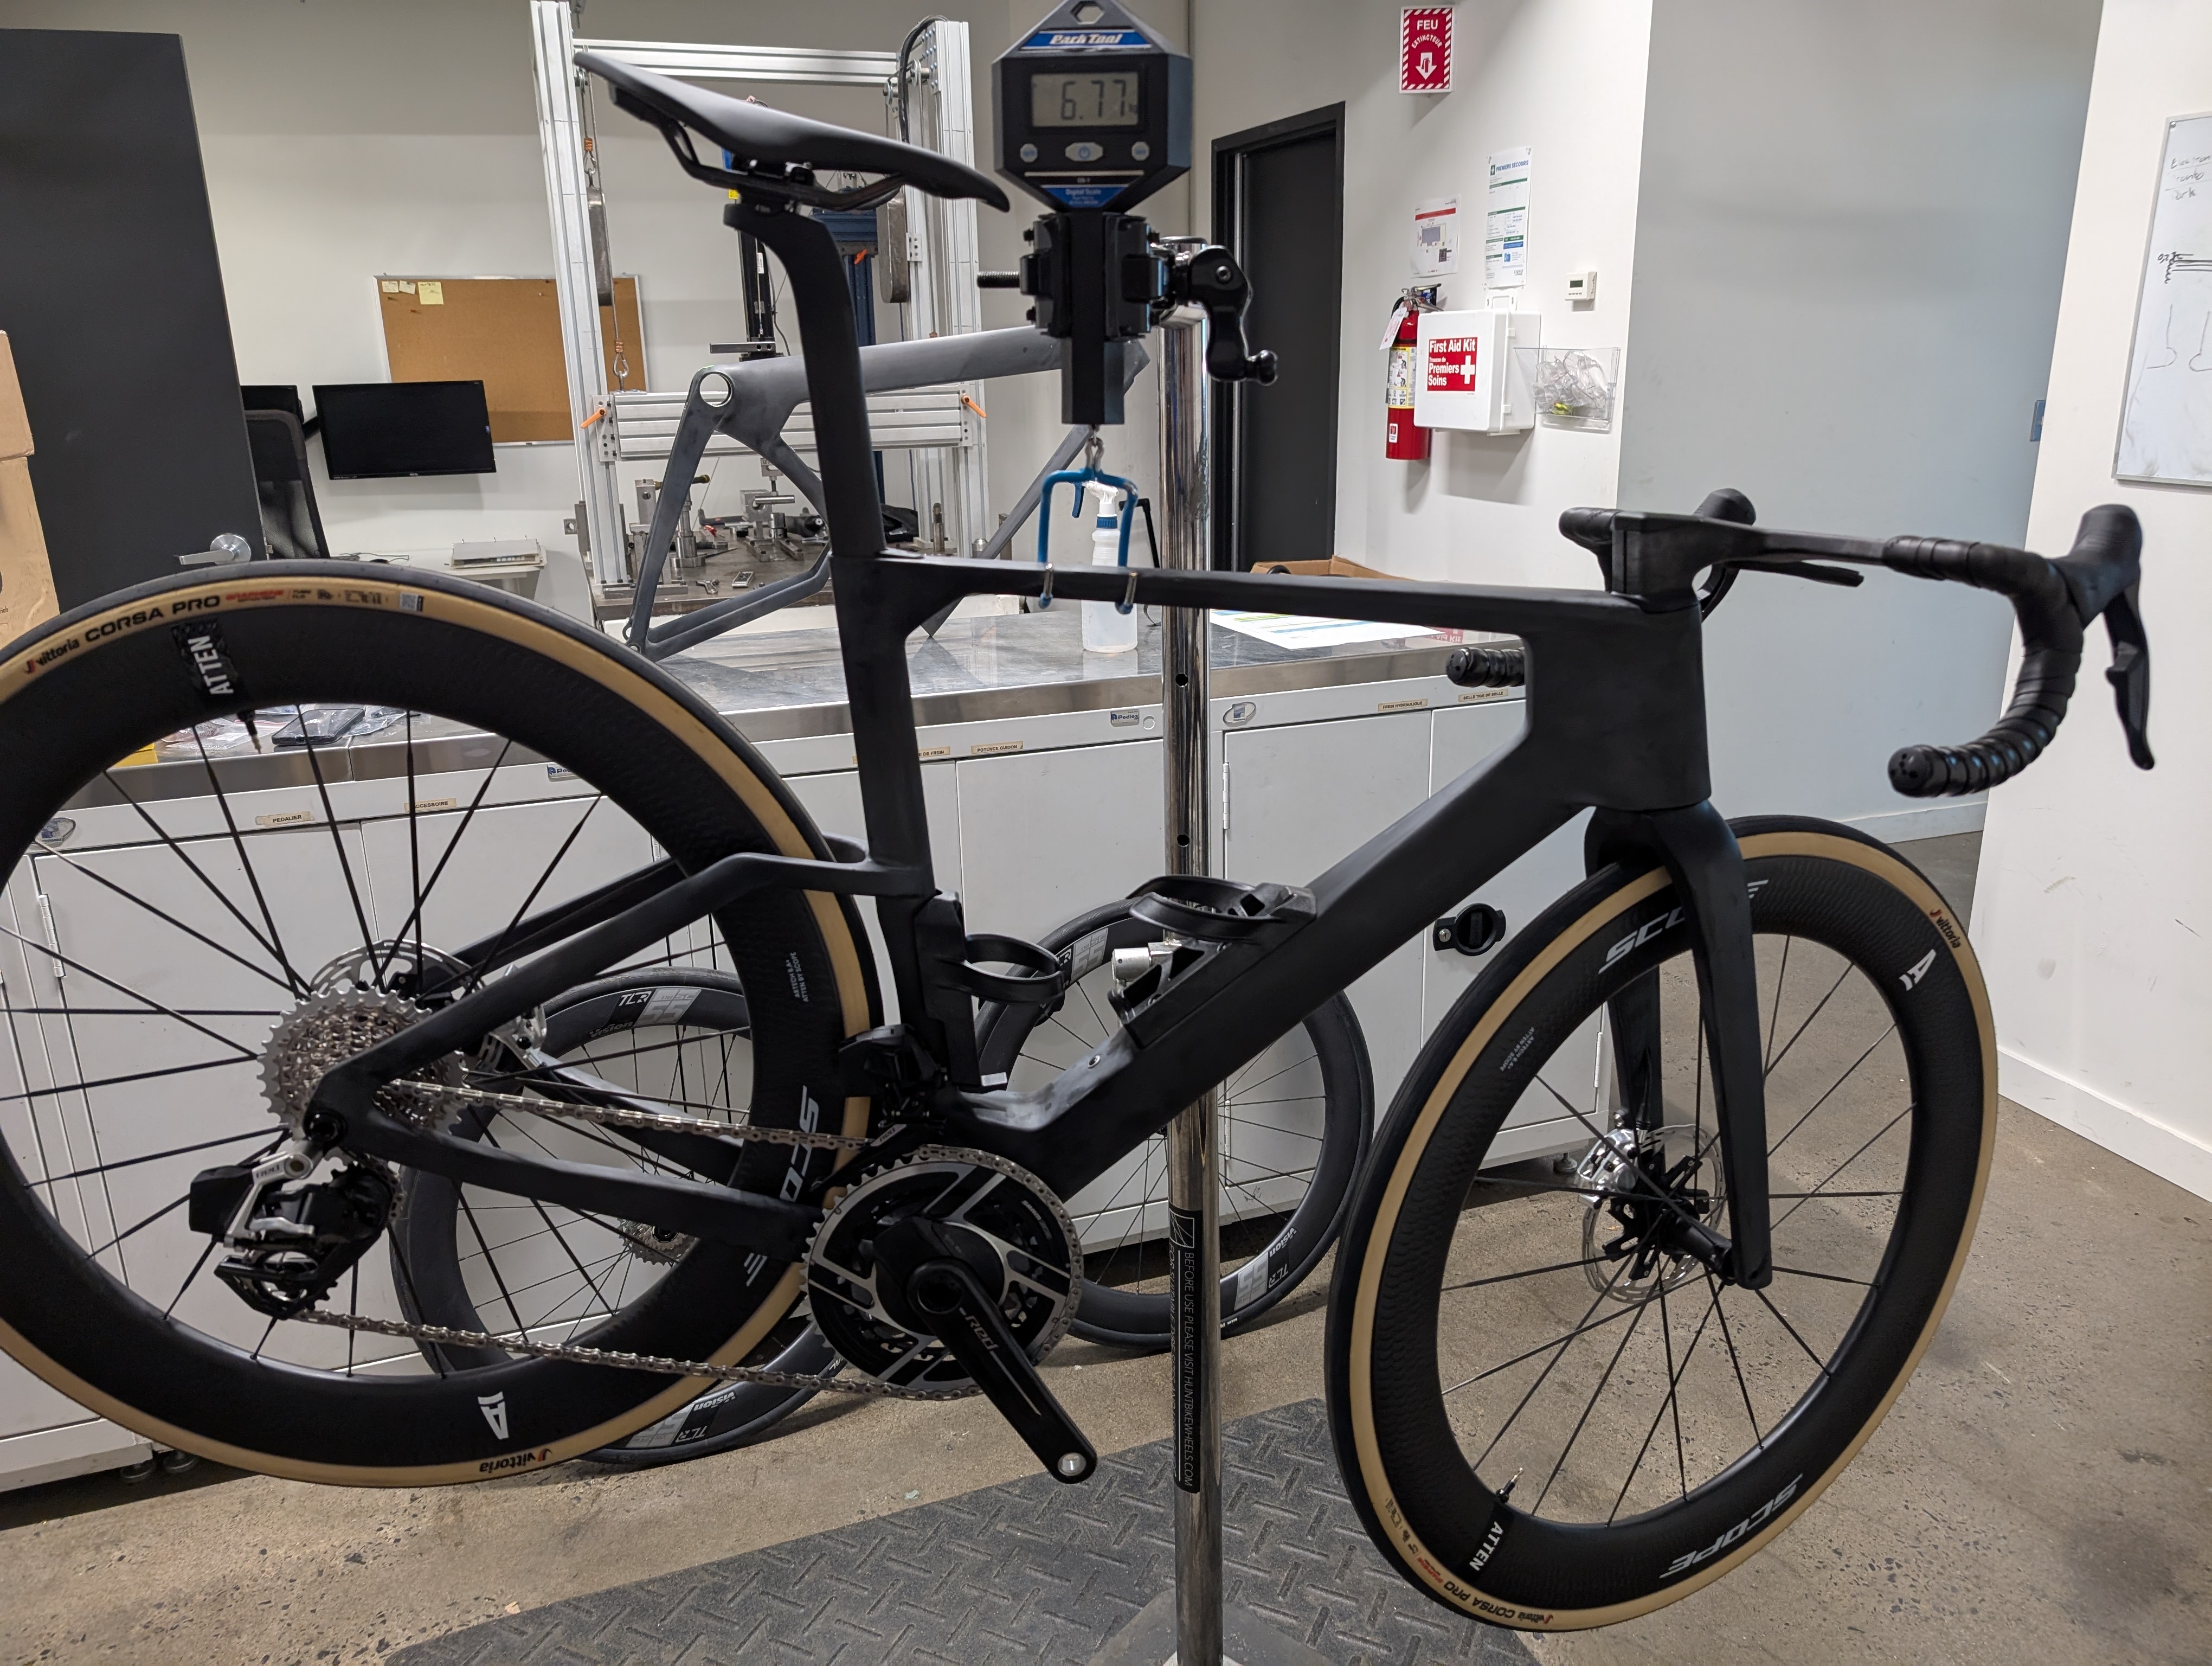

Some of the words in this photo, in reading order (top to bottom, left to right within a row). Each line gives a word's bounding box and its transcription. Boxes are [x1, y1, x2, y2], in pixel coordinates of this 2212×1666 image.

[1417, 20, 1438, 30] FEU
[1050, 34, 1086, 44] Park
[1088, 33, 1124, 44] Tool
[1411, 34, 1442, 48] EXTINCTEUR
[1060, 79, 1127, 120] 6.77
[1496, 163, 1512, 172] PREMIERS
[1512, 160, 1529, 168] SECOURS
[1430, 340, 1446, 353] First
[1448, 339, 1461, 353] Aid
[1463, 338, 1476, 351] Kit
[1429, 362, 1459, 374] Premiers
[1428, 374, 1447, 386] Soins
[35, 638, 80, 667] vittoria
[85, 608, 164, 643] CORSA
[172, 595, 221, 614] PRO
[188, 635, 234, 695] ATTEN
[414, 801, 449, 809] CCESSOIRE
[272, 815, 302, 823] PEDALIER
[1936, 919, 1961, 949] vittoria
[619, 991, 652, 1007] TLR
[1185, 1252, 1194, 1291] BEFORE
[1184, 1294, 1194, 1313] USE
[1184, 1315, 1194, 1351] PLEASE
[1184, 1353, 1194, 1376] VISIT
[1184, 1376, 1193, 1486] HUNTBIKEWHEELS.COM
[479, 1452, 536, 1473] vittoria
[1659, 1473, 1803, 1579] SCOPE
[1469, 1521, 1503, 1572] ATTEN
[1444, 1580, 1471, 1601] PRO
[1471, 1597, 1516, 1618] CORSA
